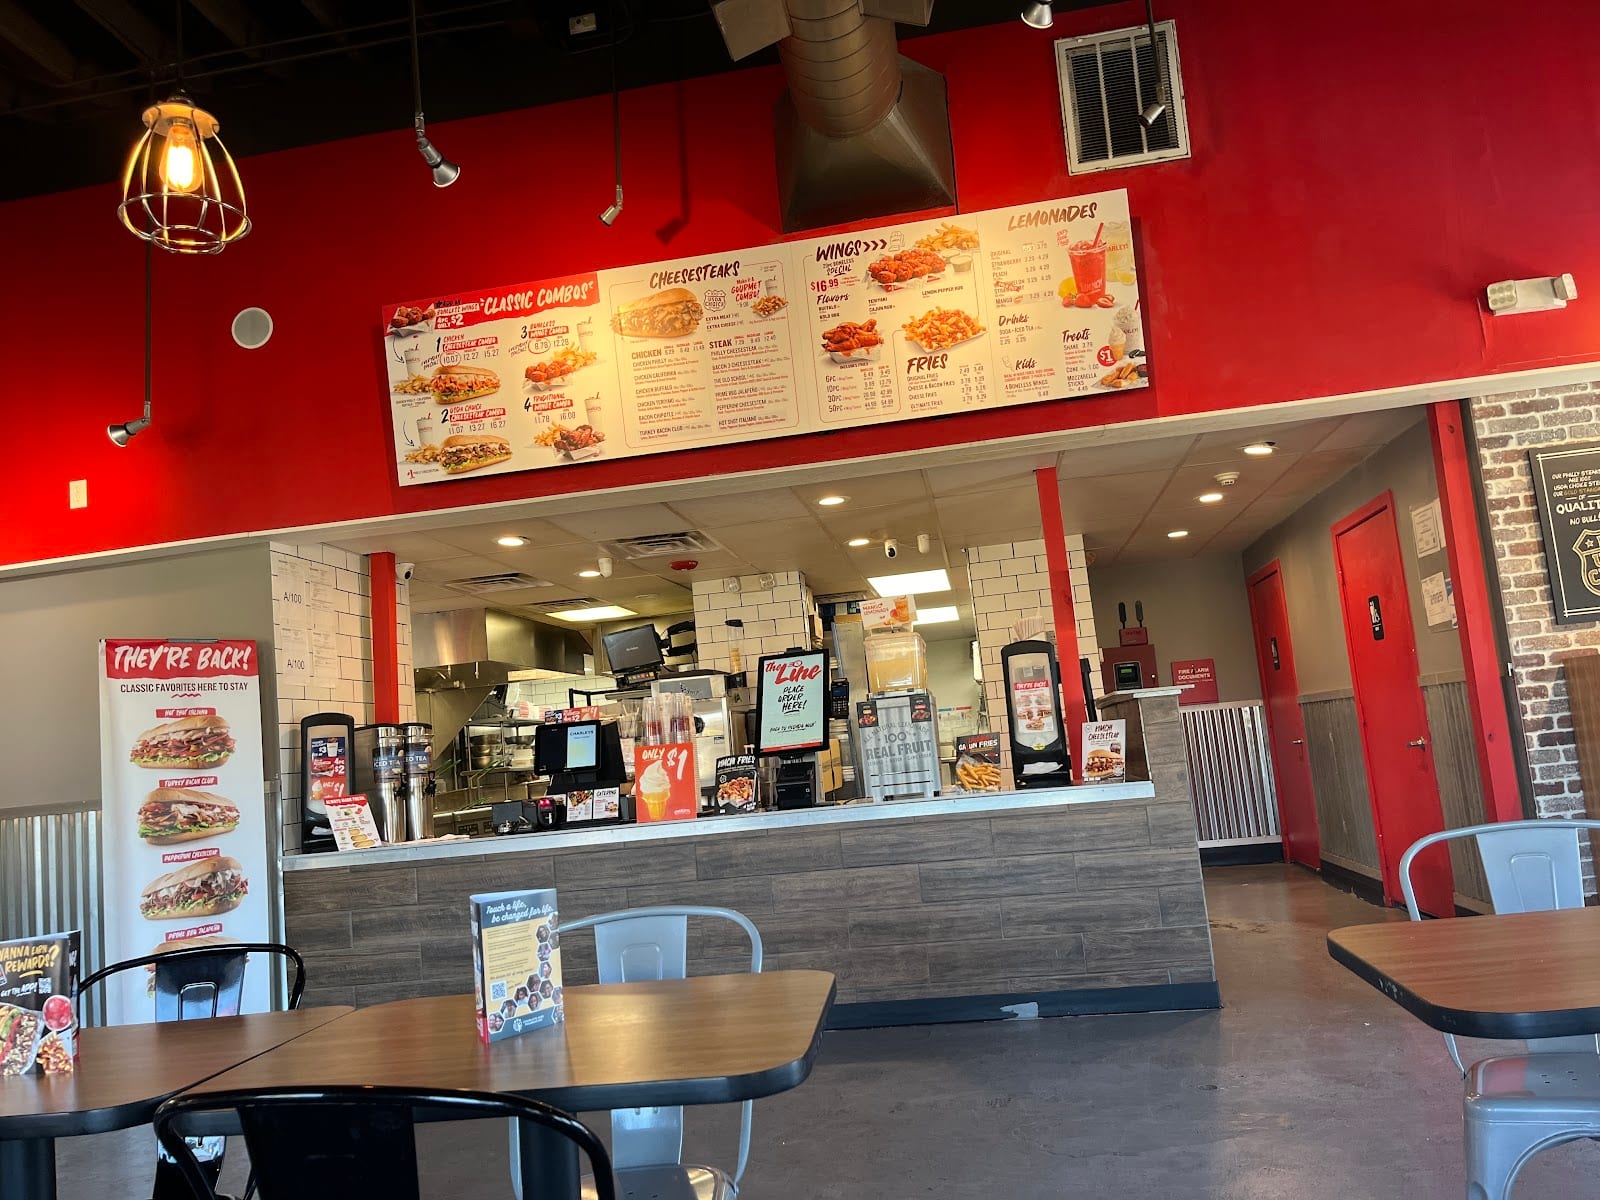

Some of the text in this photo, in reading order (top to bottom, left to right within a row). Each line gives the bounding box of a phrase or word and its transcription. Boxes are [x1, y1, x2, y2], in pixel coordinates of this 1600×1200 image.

[1008, 202, 1097, 231] LEMONADES
[816, 240, 861, 261] WINGS
[650, 261, 740, 289] CHEESESTEAKS
[826, 265, 852, 276] SPECIAL
[731, 280, 762, 294] GOURMET
[811, 279, 838, 292] $16.99
[484, 284, 588, 315] CLASSIC COMBOS
[736, 290, 760, 302] COMBO!
[817, 293, 849, 304] Flavors
[451, 314, 464, 325] $2
[999, 313, 1029, 326] Drinks
[444, 334, 464, 342] CHICKEN
[521, 325, 527, 339] 3
[1062, 328, 1092, 343] Treats
[437, 337, 441, 352] 1
[709, 339, 732, 348] STEAK
[632, 349, 662, 360] CHICKEN
[726, 346, 756, 354] CHEESESTEAK
[1100, 350, 1115, 362] $1
[731, 359, 762, 368] CHEESESTEAK
[907, 353, 948, 374] FRIES
[1016, 358, 1039, 370] Kids
[534, 393, 565, 402] TRADITIONAL
[524, 397, 532, 412] 4
[739, 400, 767, 408] CHEESESTEAK
[441, 408, 449, 423] 2
[1569, 481, 1587, 489] CHOICE
[1570, 517, 1580, 525] NO
[284, 592, 301, 604] A/100
[114, 645, 192, 673] THEY'RE
[197, 646, 251, 671] BACK!
[287, 659, 305, 670] A/100
[766, 661, 821, 685] the Line
[120, 682, 248, 693] CLASSIC FAVORITES HERE TO STAY
[783, 684, 804, 694] PLACE
[778, 693, 804, 702] ORDER
[782, 700, 807, 712] HERE!
[979, 739, 997, 748] FRIES
[866, 740, 931, 760] REAL FRUIT
[642, 747, 688, 780] ONLY $1
[737, 755, 755, 764] FRIES
[334, 765, 345, 774] $2
[164, 779, 184, 787] TURKEY
[201, 777, 214, 785] CLUB
[486, 904, 505, 914] Touch
[512, 900, 527, 910] life,
[491, 904, 554, 923] be changed for life.
[32, 945, 48, 954] EARN
[5, 944, 60, 974] REWARDS?
[1, 989, 10, 997] GET
[21, 982, 37, 993] APP!
